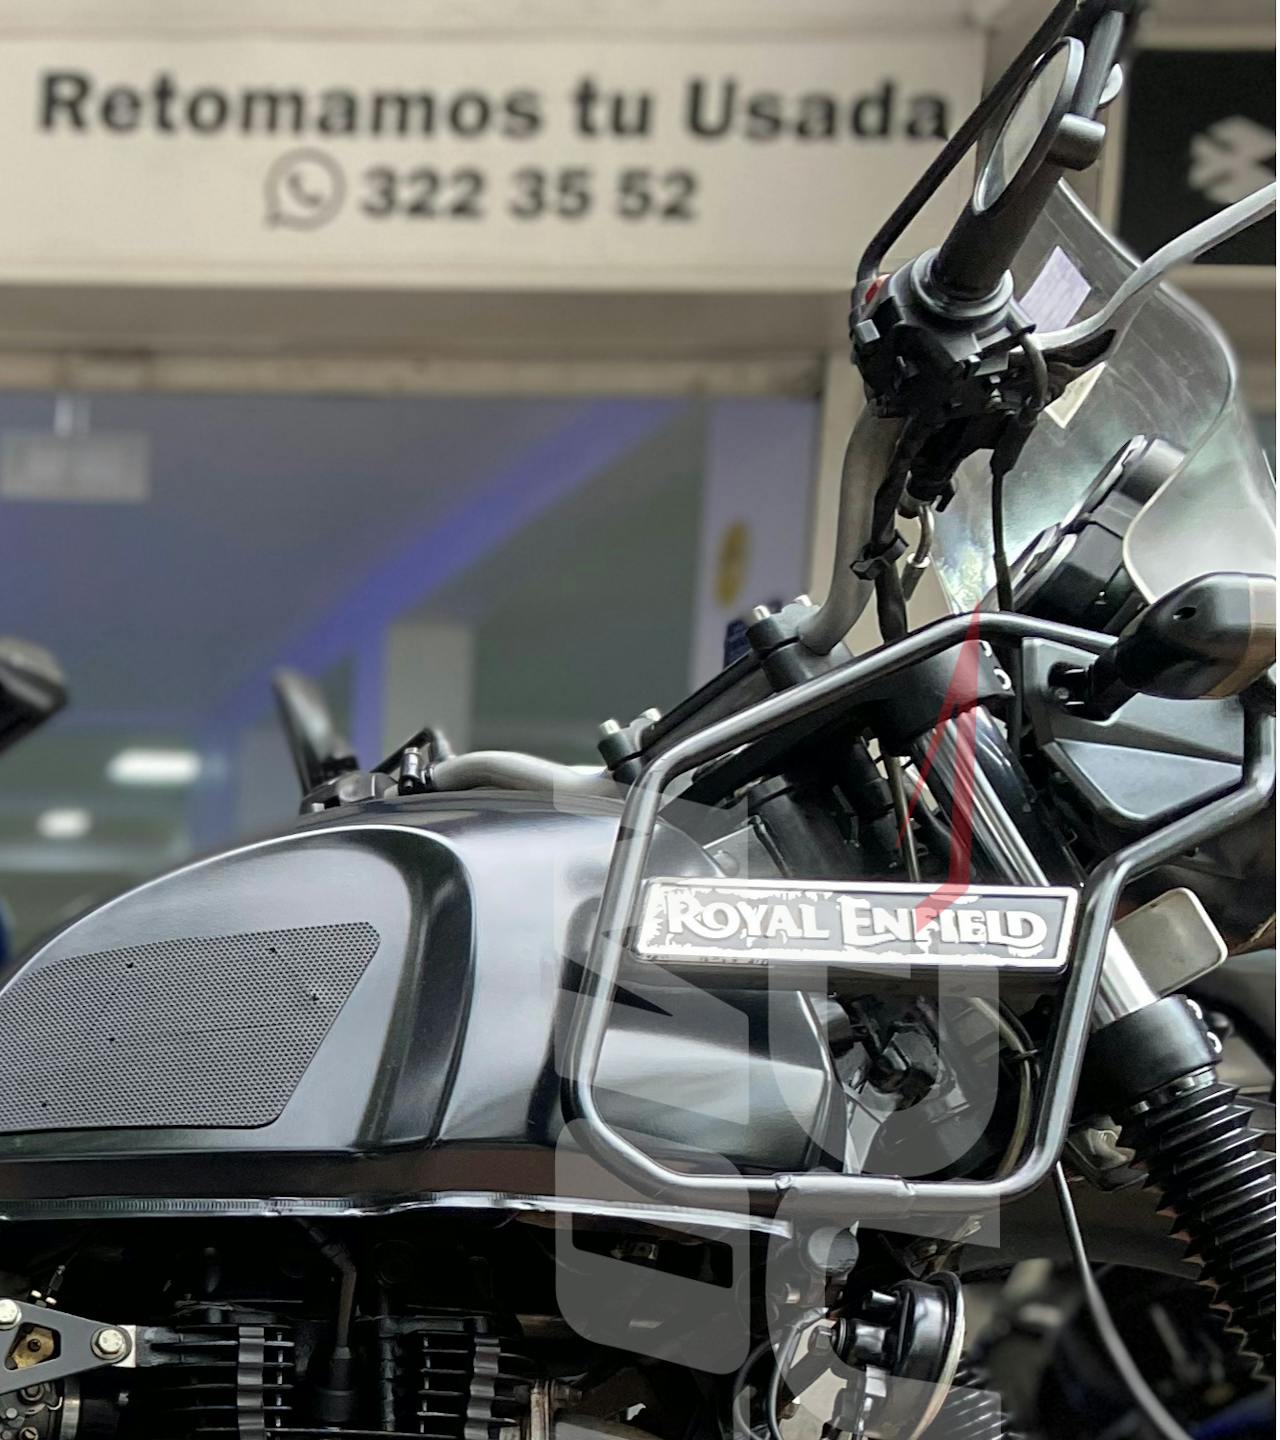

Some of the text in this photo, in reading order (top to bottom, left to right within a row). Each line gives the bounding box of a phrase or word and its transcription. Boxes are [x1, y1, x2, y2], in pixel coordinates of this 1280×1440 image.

[38, 68, 952, 143] Retomamos tu Usada
[358, 163, 699, 222] 322 35 52
[666, 889, 1049, 950] ROYAL ENFIELD
